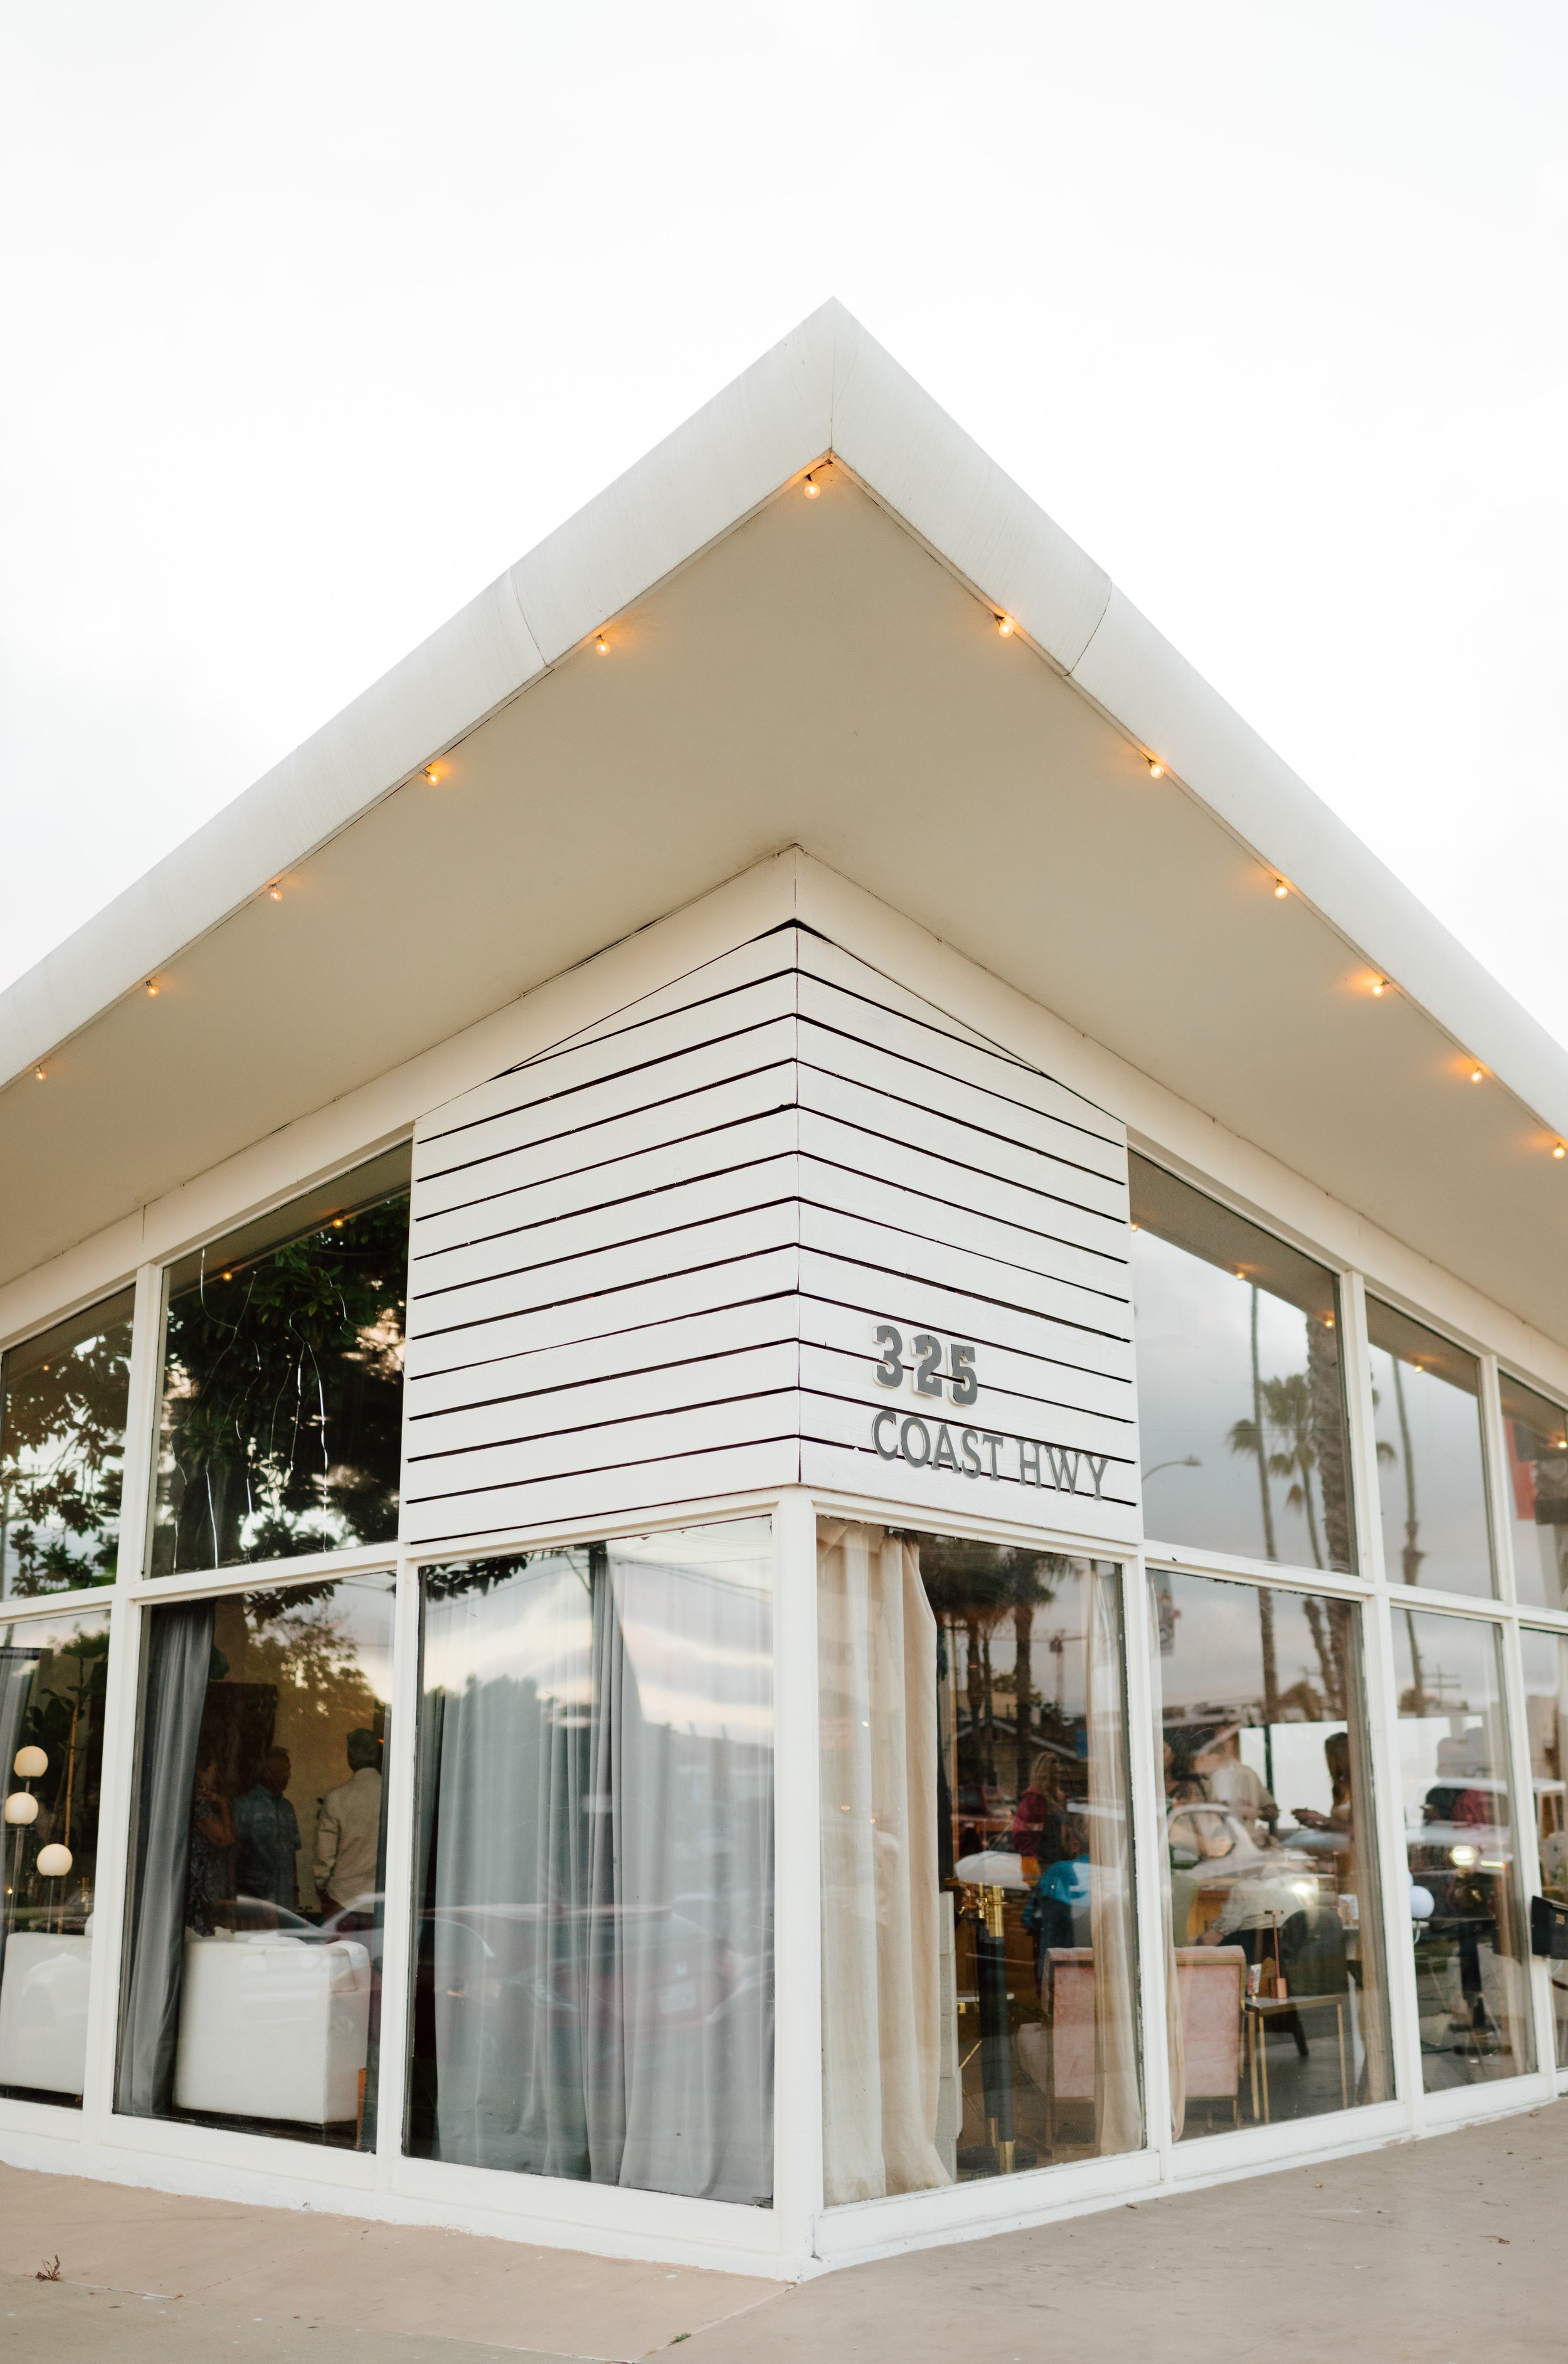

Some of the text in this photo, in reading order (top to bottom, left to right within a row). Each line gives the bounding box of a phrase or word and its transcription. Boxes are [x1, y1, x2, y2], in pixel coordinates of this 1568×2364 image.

[872, 1325, 978, 1405] 325
[872, 1411, 1109, 1500] COAST HWY
